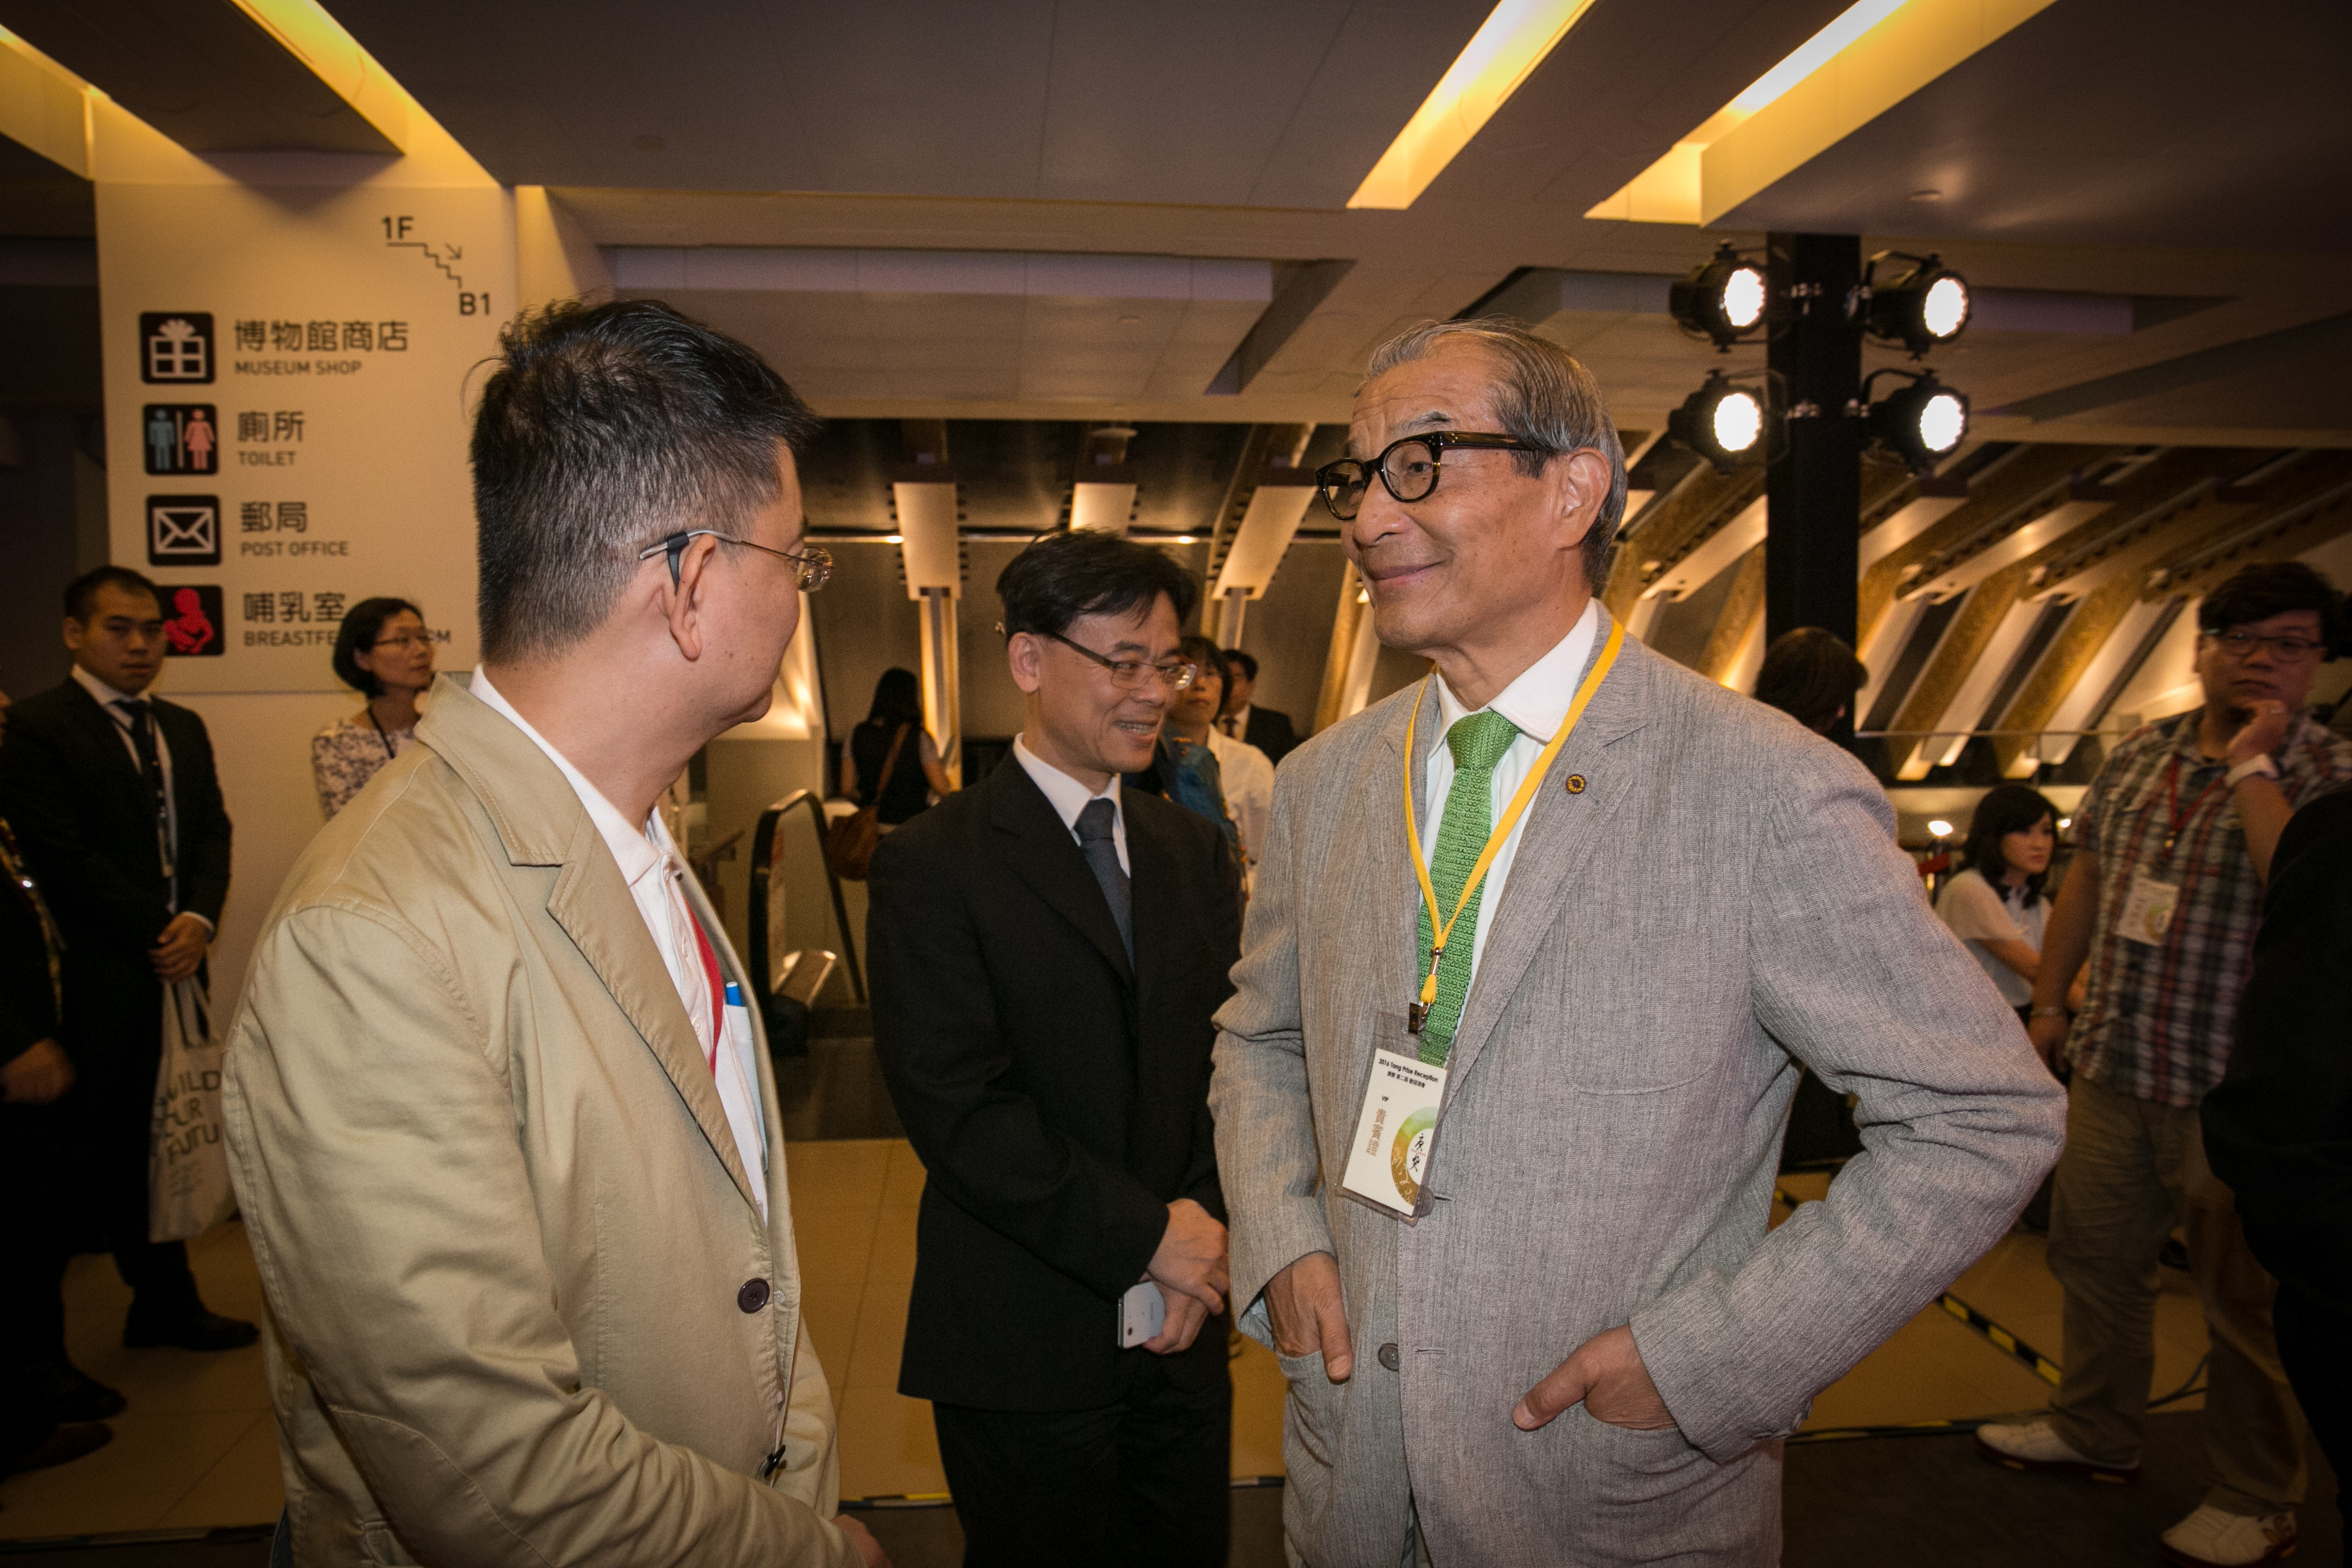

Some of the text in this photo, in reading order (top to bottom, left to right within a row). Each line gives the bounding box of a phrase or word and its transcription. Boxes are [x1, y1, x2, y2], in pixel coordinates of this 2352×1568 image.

[382, 216, 413, 238] 1F
[459, 292, 490, 315] B1
[235, 321, 409, 352] 博物館商店
[235, 360, 362, 375] MUSEUM SHOP
[239, 450, 295, 466] TOILET
[241, 502, 307, 532] 郵局
[241, 540, 349, 556] POST OFFICE
[244, 592, 346, 622] 哺乳室
[244, 630, 337, 646] BREASTFE
[1379, 1058, 1438, 1083] 2016 Tang Prize Reception
[166, 1123, 220, 1165] FUTU
[1366, 1109, 1386, 1156] 貴賓證
